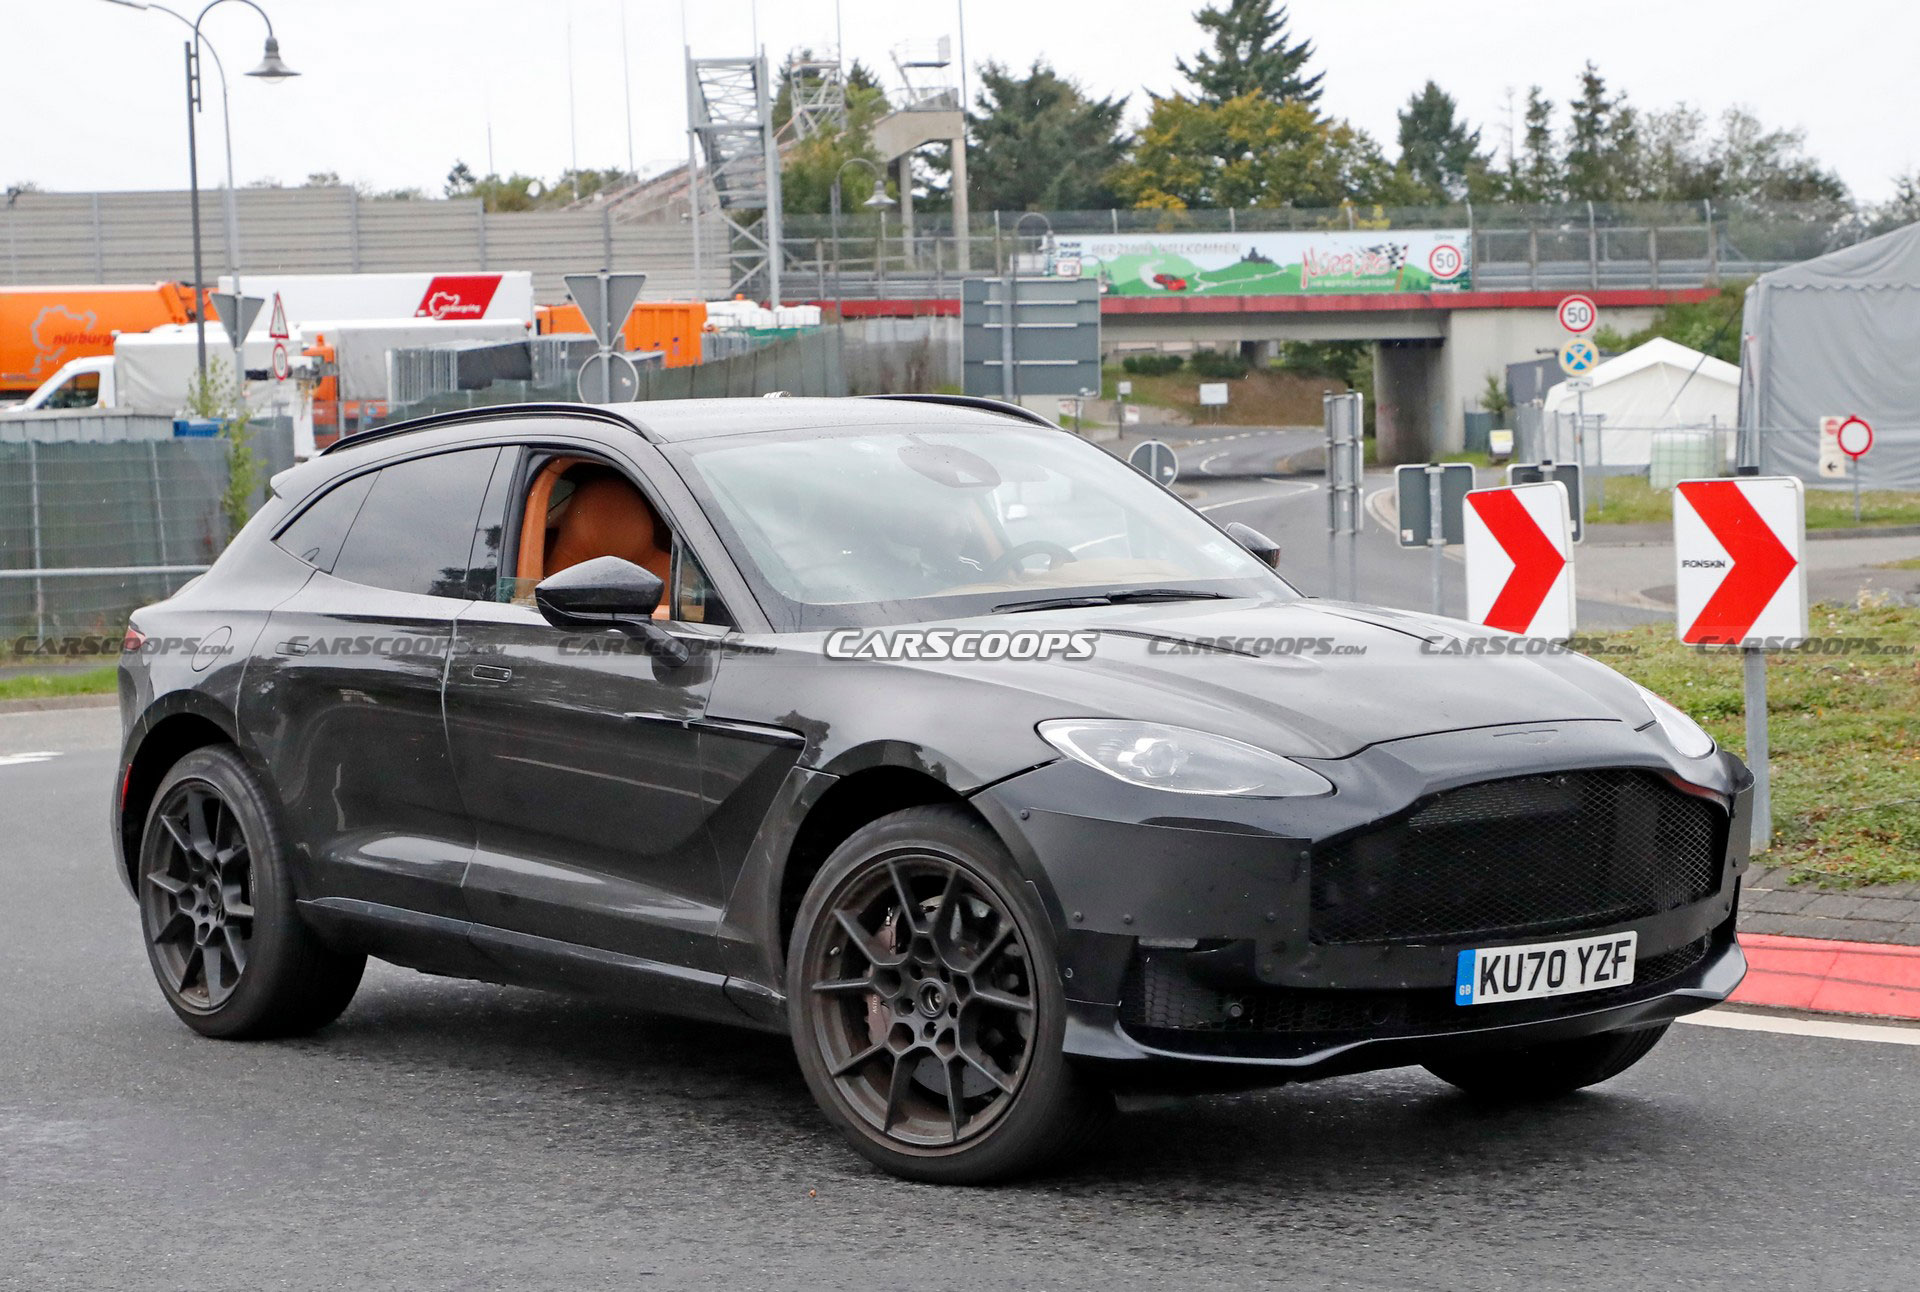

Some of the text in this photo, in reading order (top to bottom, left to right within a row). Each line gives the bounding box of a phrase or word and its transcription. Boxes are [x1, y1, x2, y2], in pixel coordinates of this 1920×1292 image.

[1436, 253, 1456, 269] 50
[1567, 306, 1588, 324] 50
[53, 331, 115, 347] nürburg
[1479, 939, 1632, 996] KU70 YZF
[1459, 984, 1472, 996] GB
